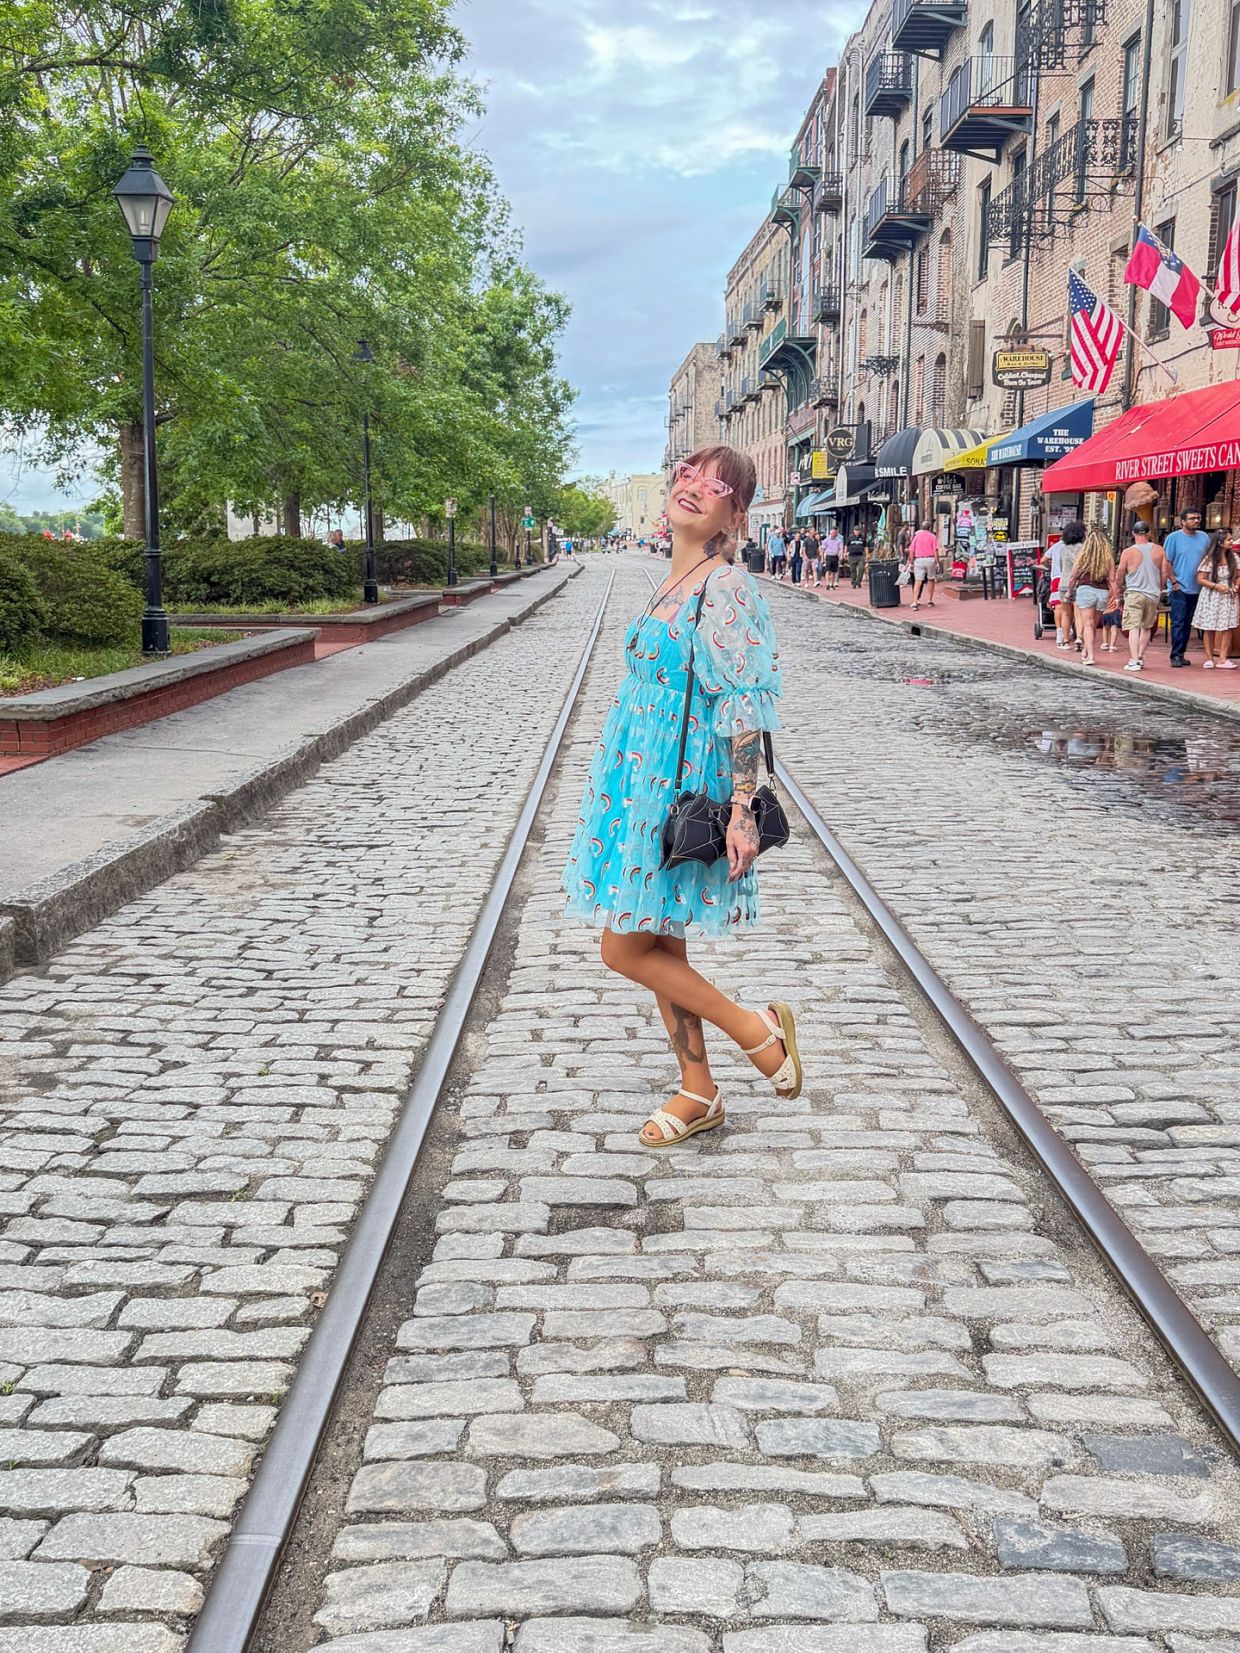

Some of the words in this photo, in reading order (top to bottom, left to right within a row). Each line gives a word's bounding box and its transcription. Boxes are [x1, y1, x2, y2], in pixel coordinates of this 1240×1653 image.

[828, 437, 853, 447] VRG
[1115, 458, 1140, 481] RIVER
[1141, 452, 1176, 477] STREET
[1176, 445, 1217, 473] SWEETS
